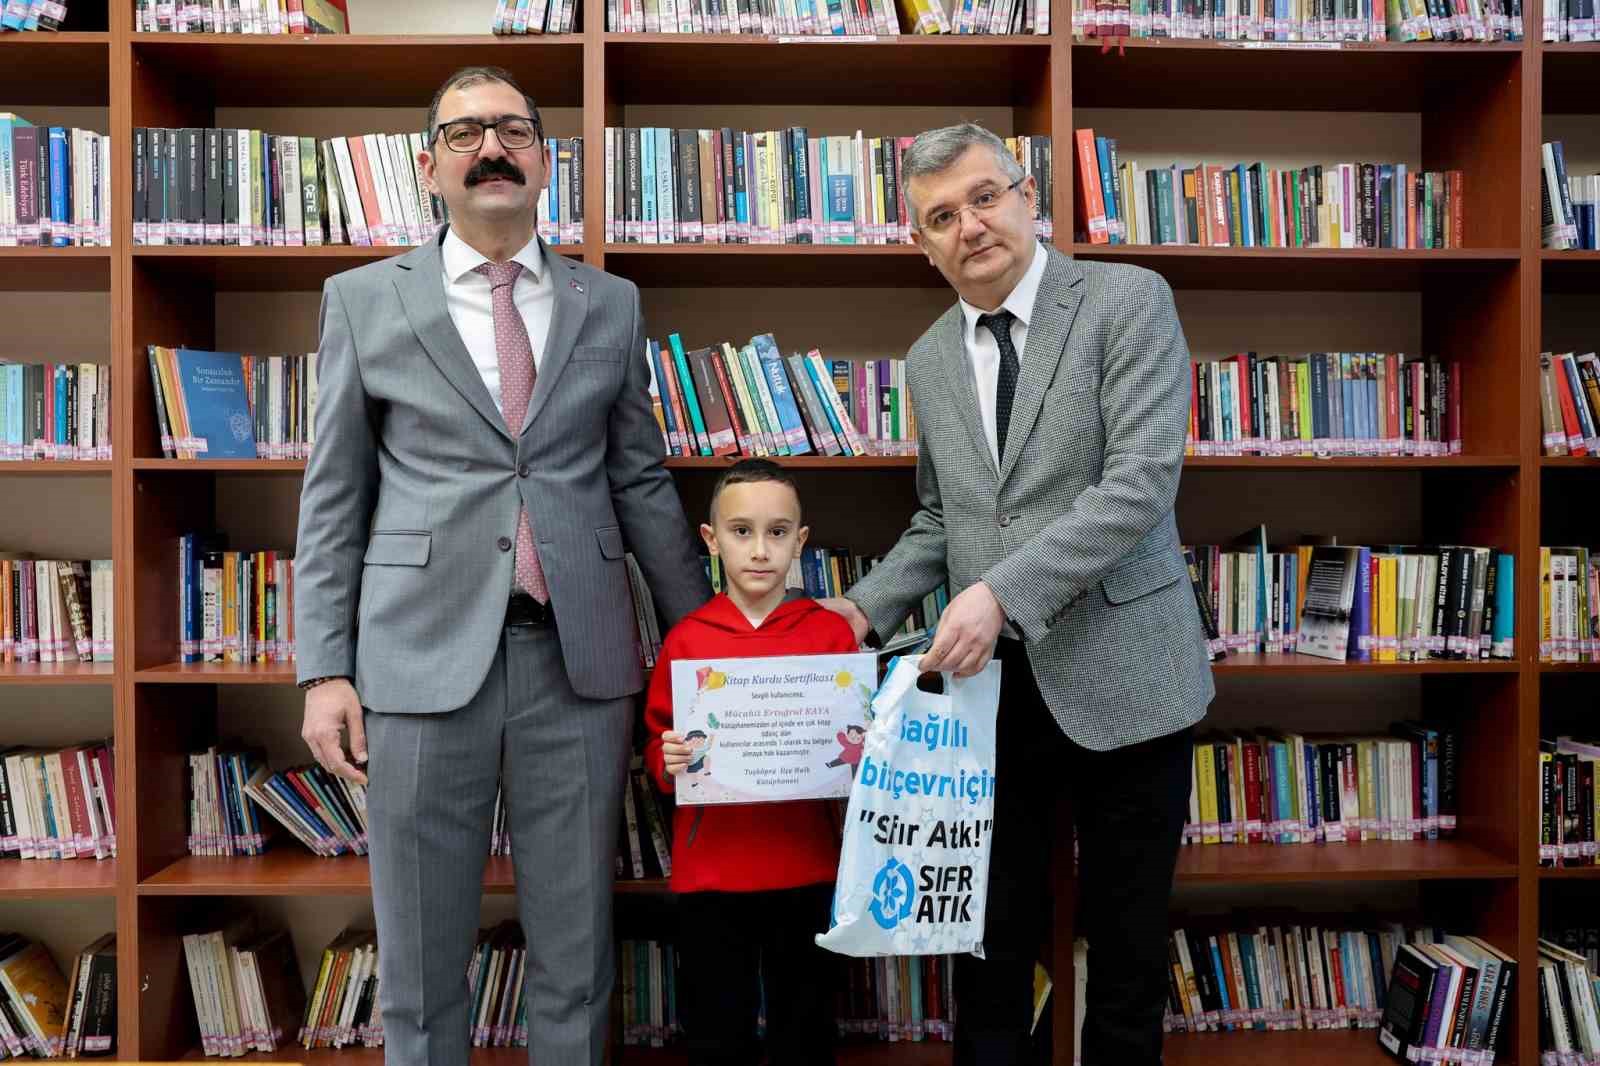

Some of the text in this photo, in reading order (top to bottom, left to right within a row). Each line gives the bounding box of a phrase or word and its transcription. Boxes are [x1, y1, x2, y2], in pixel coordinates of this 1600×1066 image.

[303, 183, 317, 214] ÇETE
[723, 674, 749, 687] Kitap
[752, 674, 782, 685] Kurdu
[804, 707, 830, 716] KAYA
[918, 865, 973, 892] SIFR
[916, 894, 973, 923] ATIK
